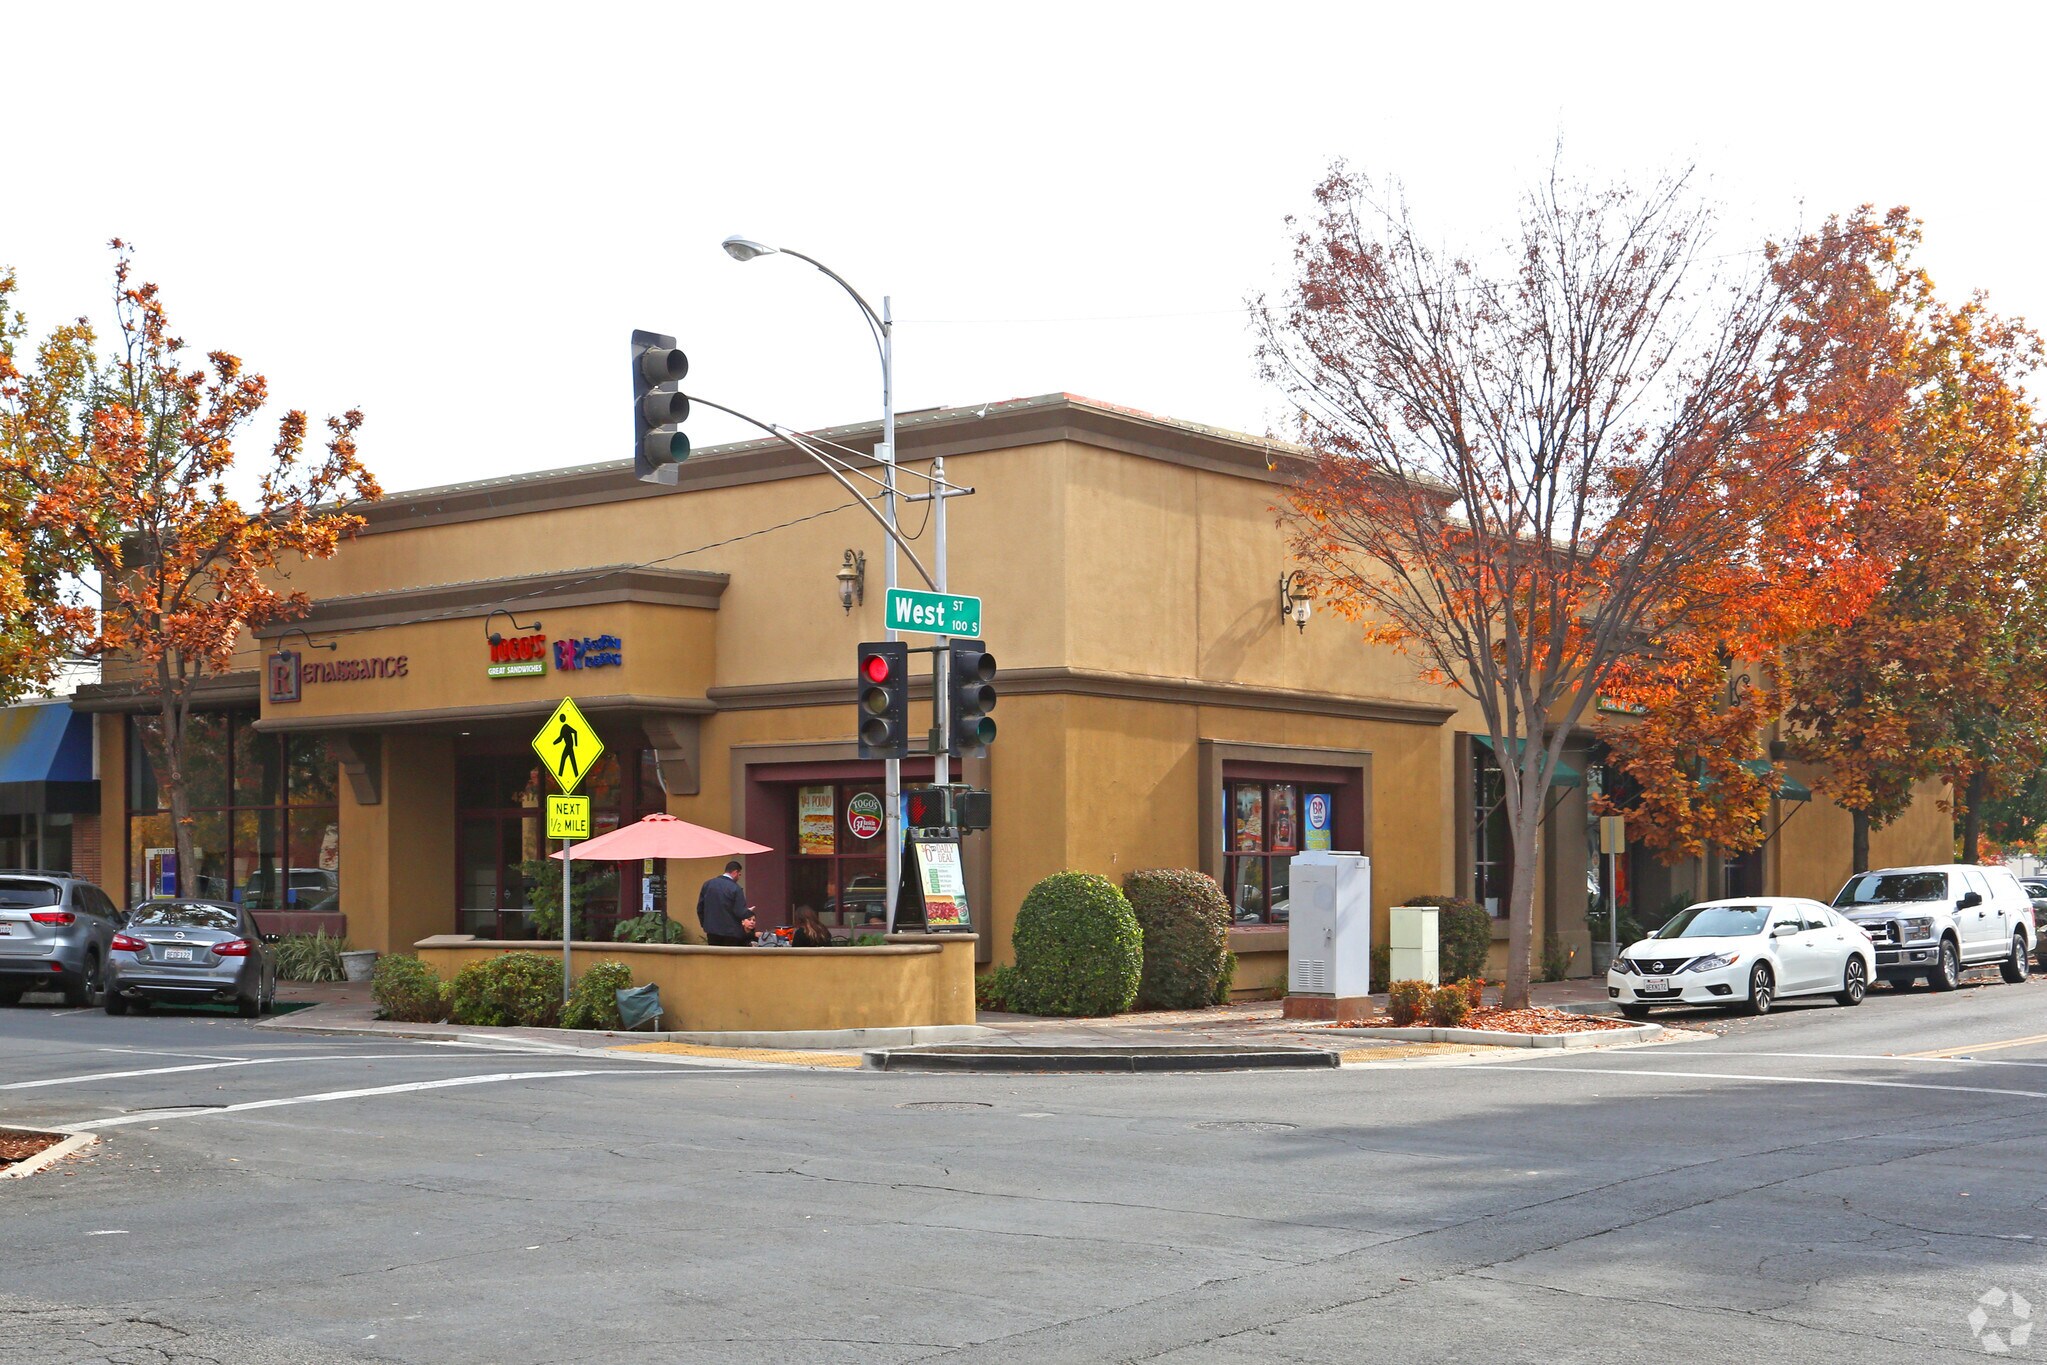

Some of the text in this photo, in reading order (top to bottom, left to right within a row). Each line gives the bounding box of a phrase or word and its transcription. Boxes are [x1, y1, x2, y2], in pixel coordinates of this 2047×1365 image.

[896, 596, 964, 627] West ST
[952, 619, 978, 633] 100 S
[488, 664, 543, 675] GREAT SANDWICHES
[556, 803, 581, 815] NEXT
[564, 819, 587, 831] MILE
